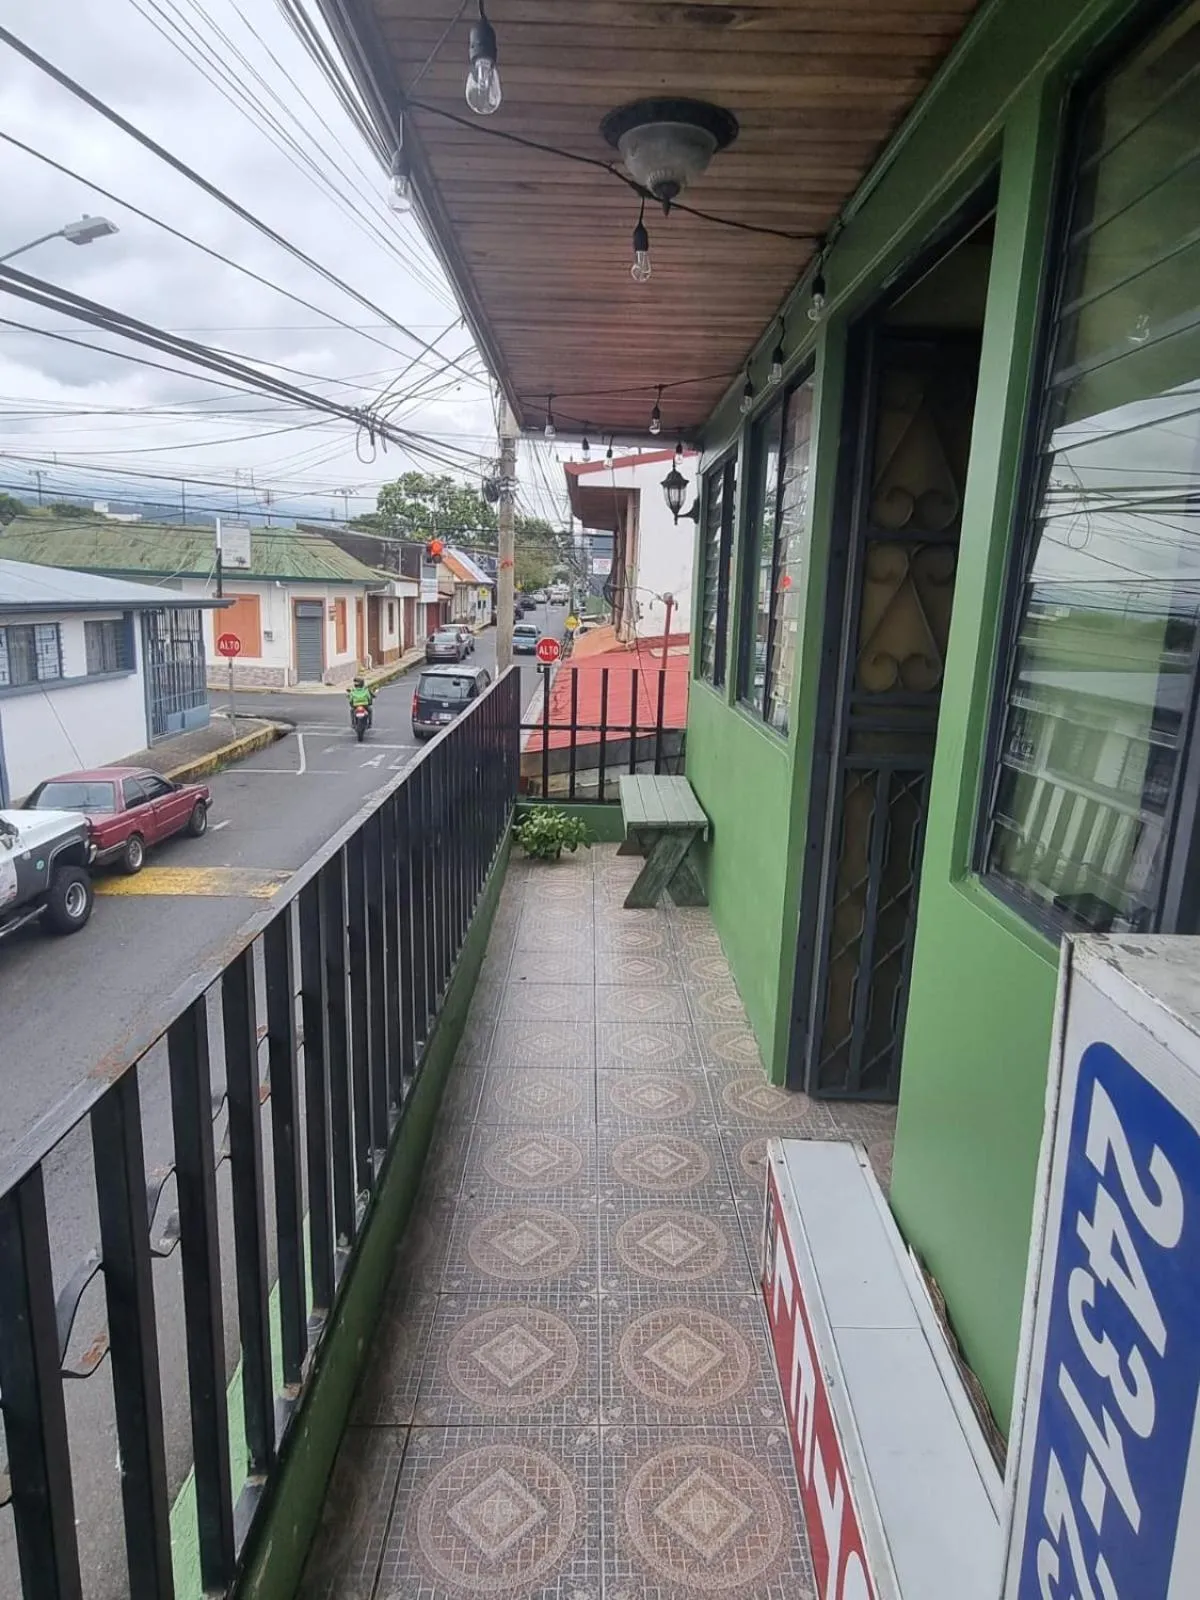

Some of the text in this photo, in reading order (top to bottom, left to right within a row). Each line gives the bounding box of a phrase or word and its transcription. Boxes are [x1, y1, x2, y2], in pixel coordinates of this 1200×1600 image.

[219, 639, 240, 651] ALTO
[539, 645, 559, 656] ALTO
[1036, 1077, 1184, 1600] 2431-2
